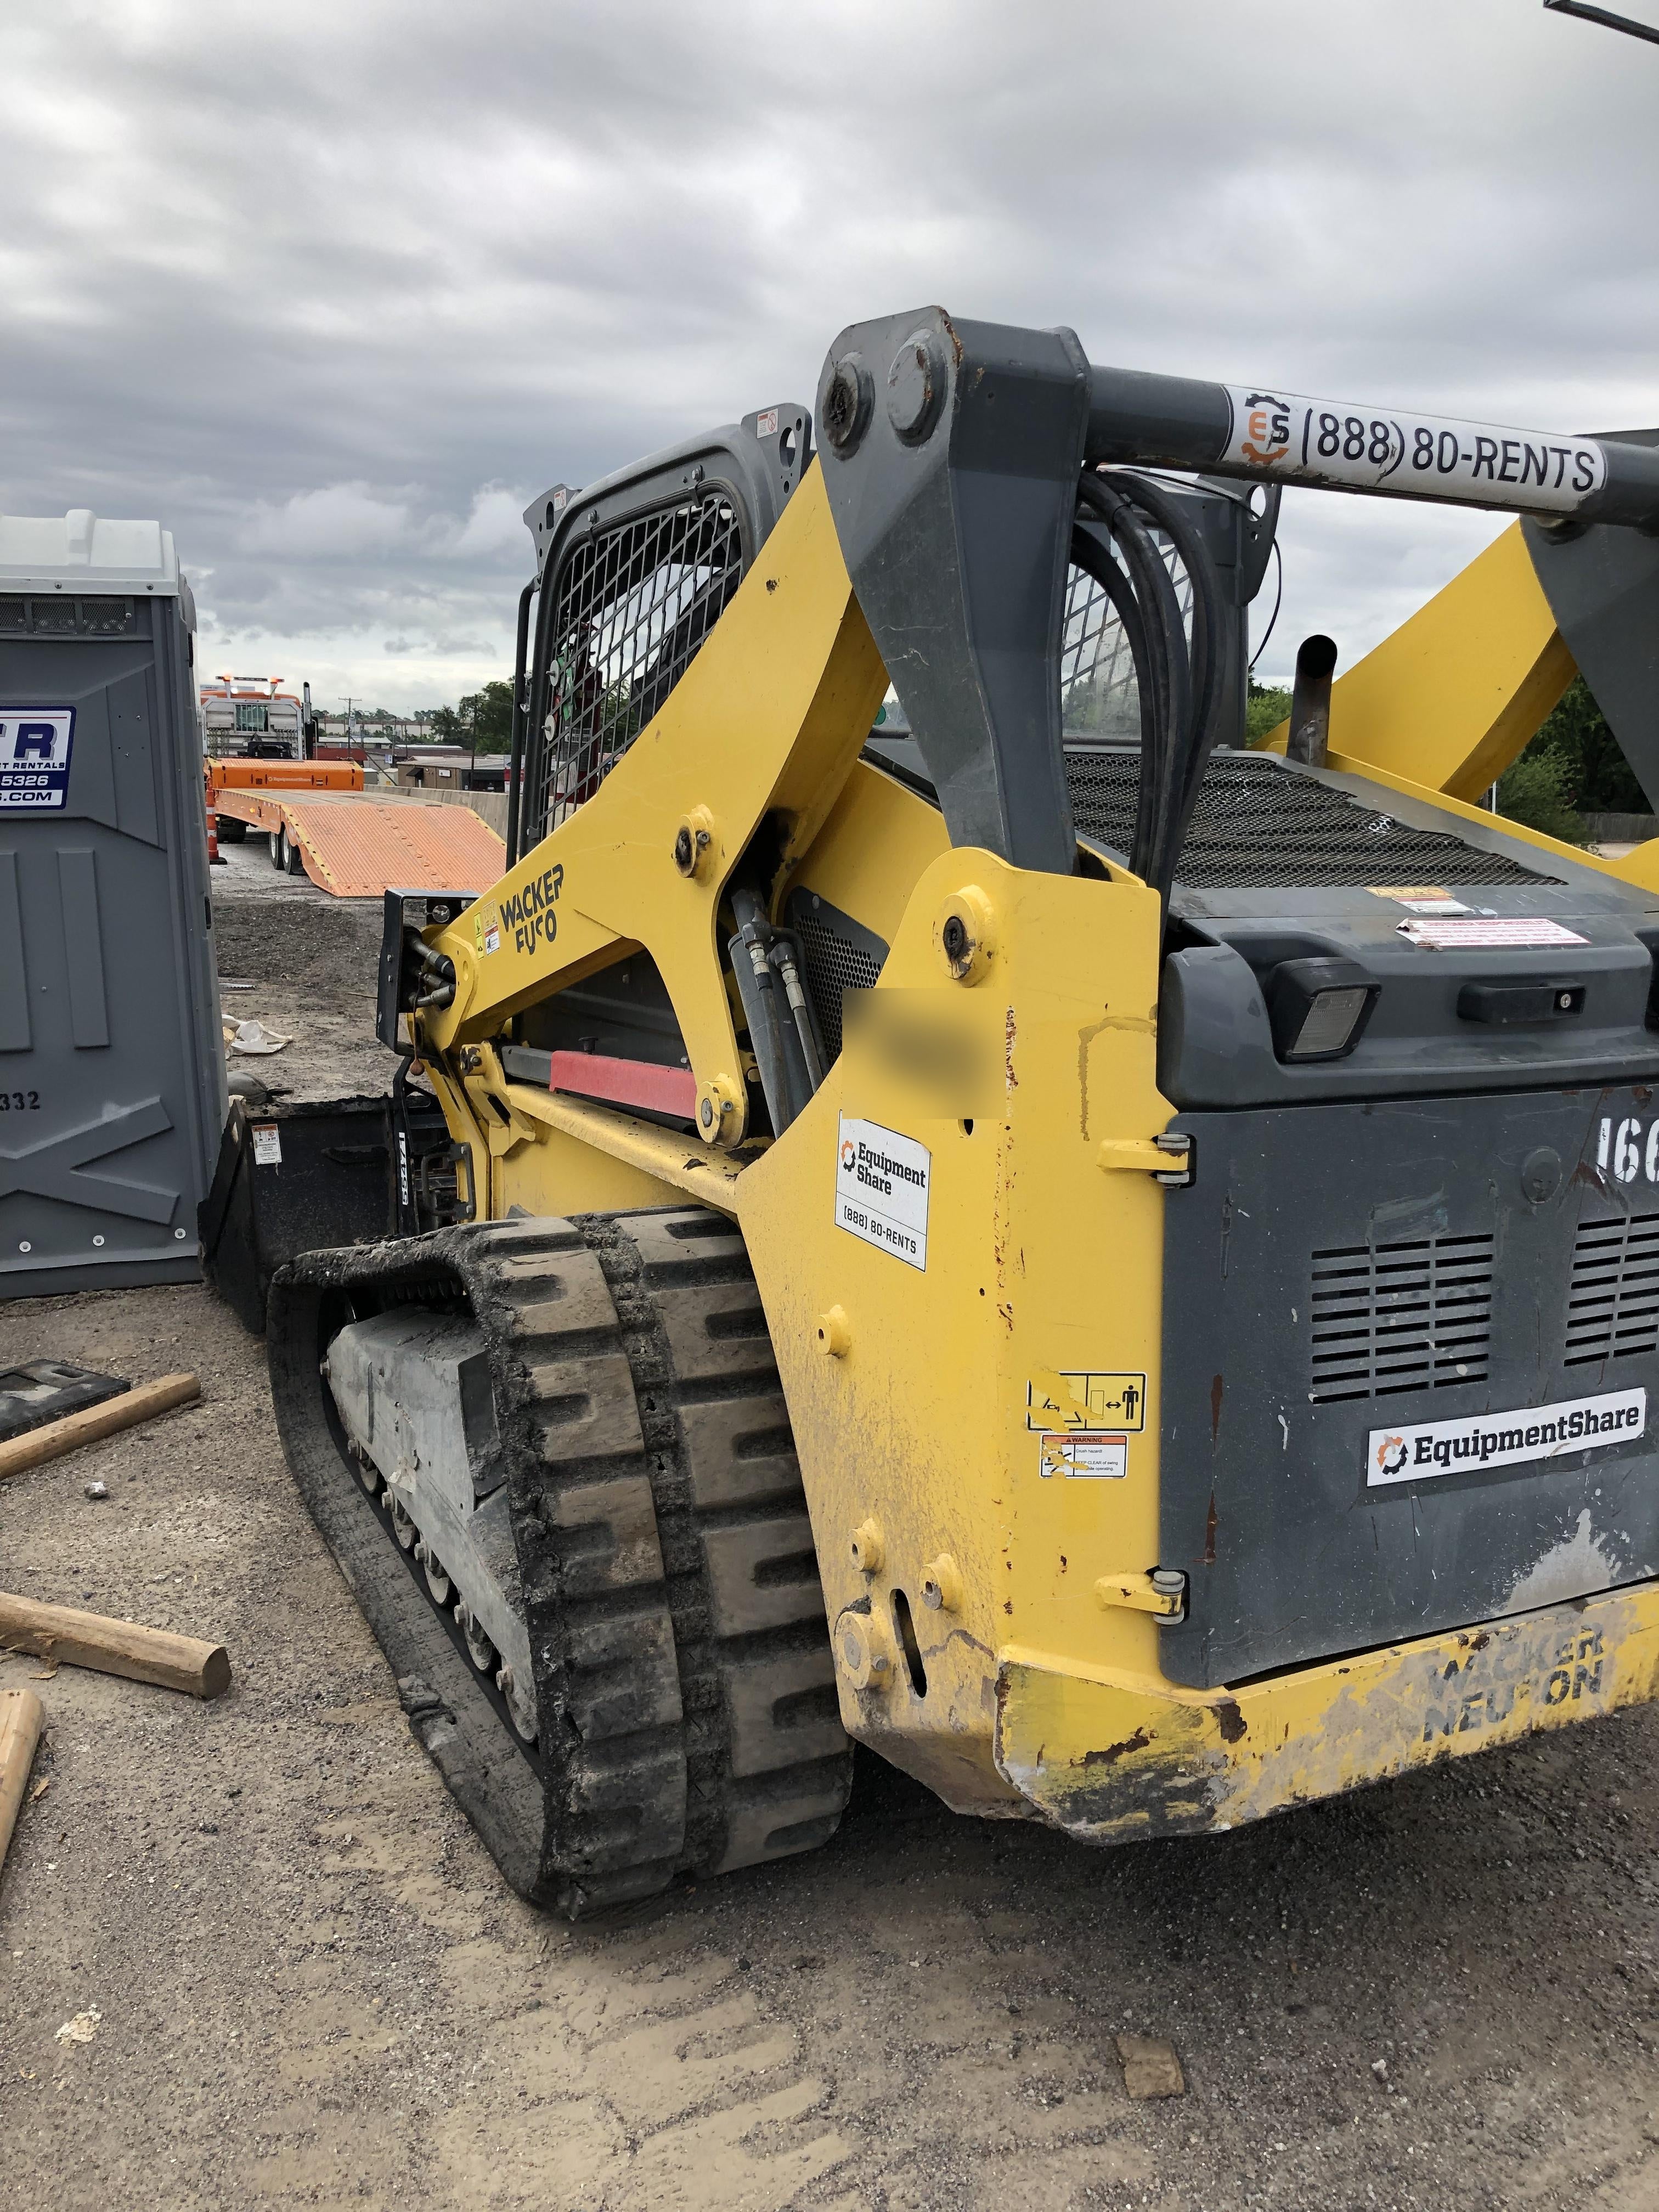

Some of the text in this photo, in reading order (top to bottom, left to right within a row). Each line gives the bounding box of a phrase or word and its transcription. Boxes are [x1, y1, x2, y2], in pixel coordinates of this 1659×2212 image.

[1302, 408, 1595, 492] (888) 80-RENTS
[399, 1137, 408, 1203] 55471
[857, 1164, 892, 1195] Share
[858, 1142, 926, 1188] Equipment
[844, 1205, 917, 1254] (888) 80-RENTS
[1413, 1406, 1639, 1468] EquipmentShare
[1423, 1659, 1604, 1742] NEUON
